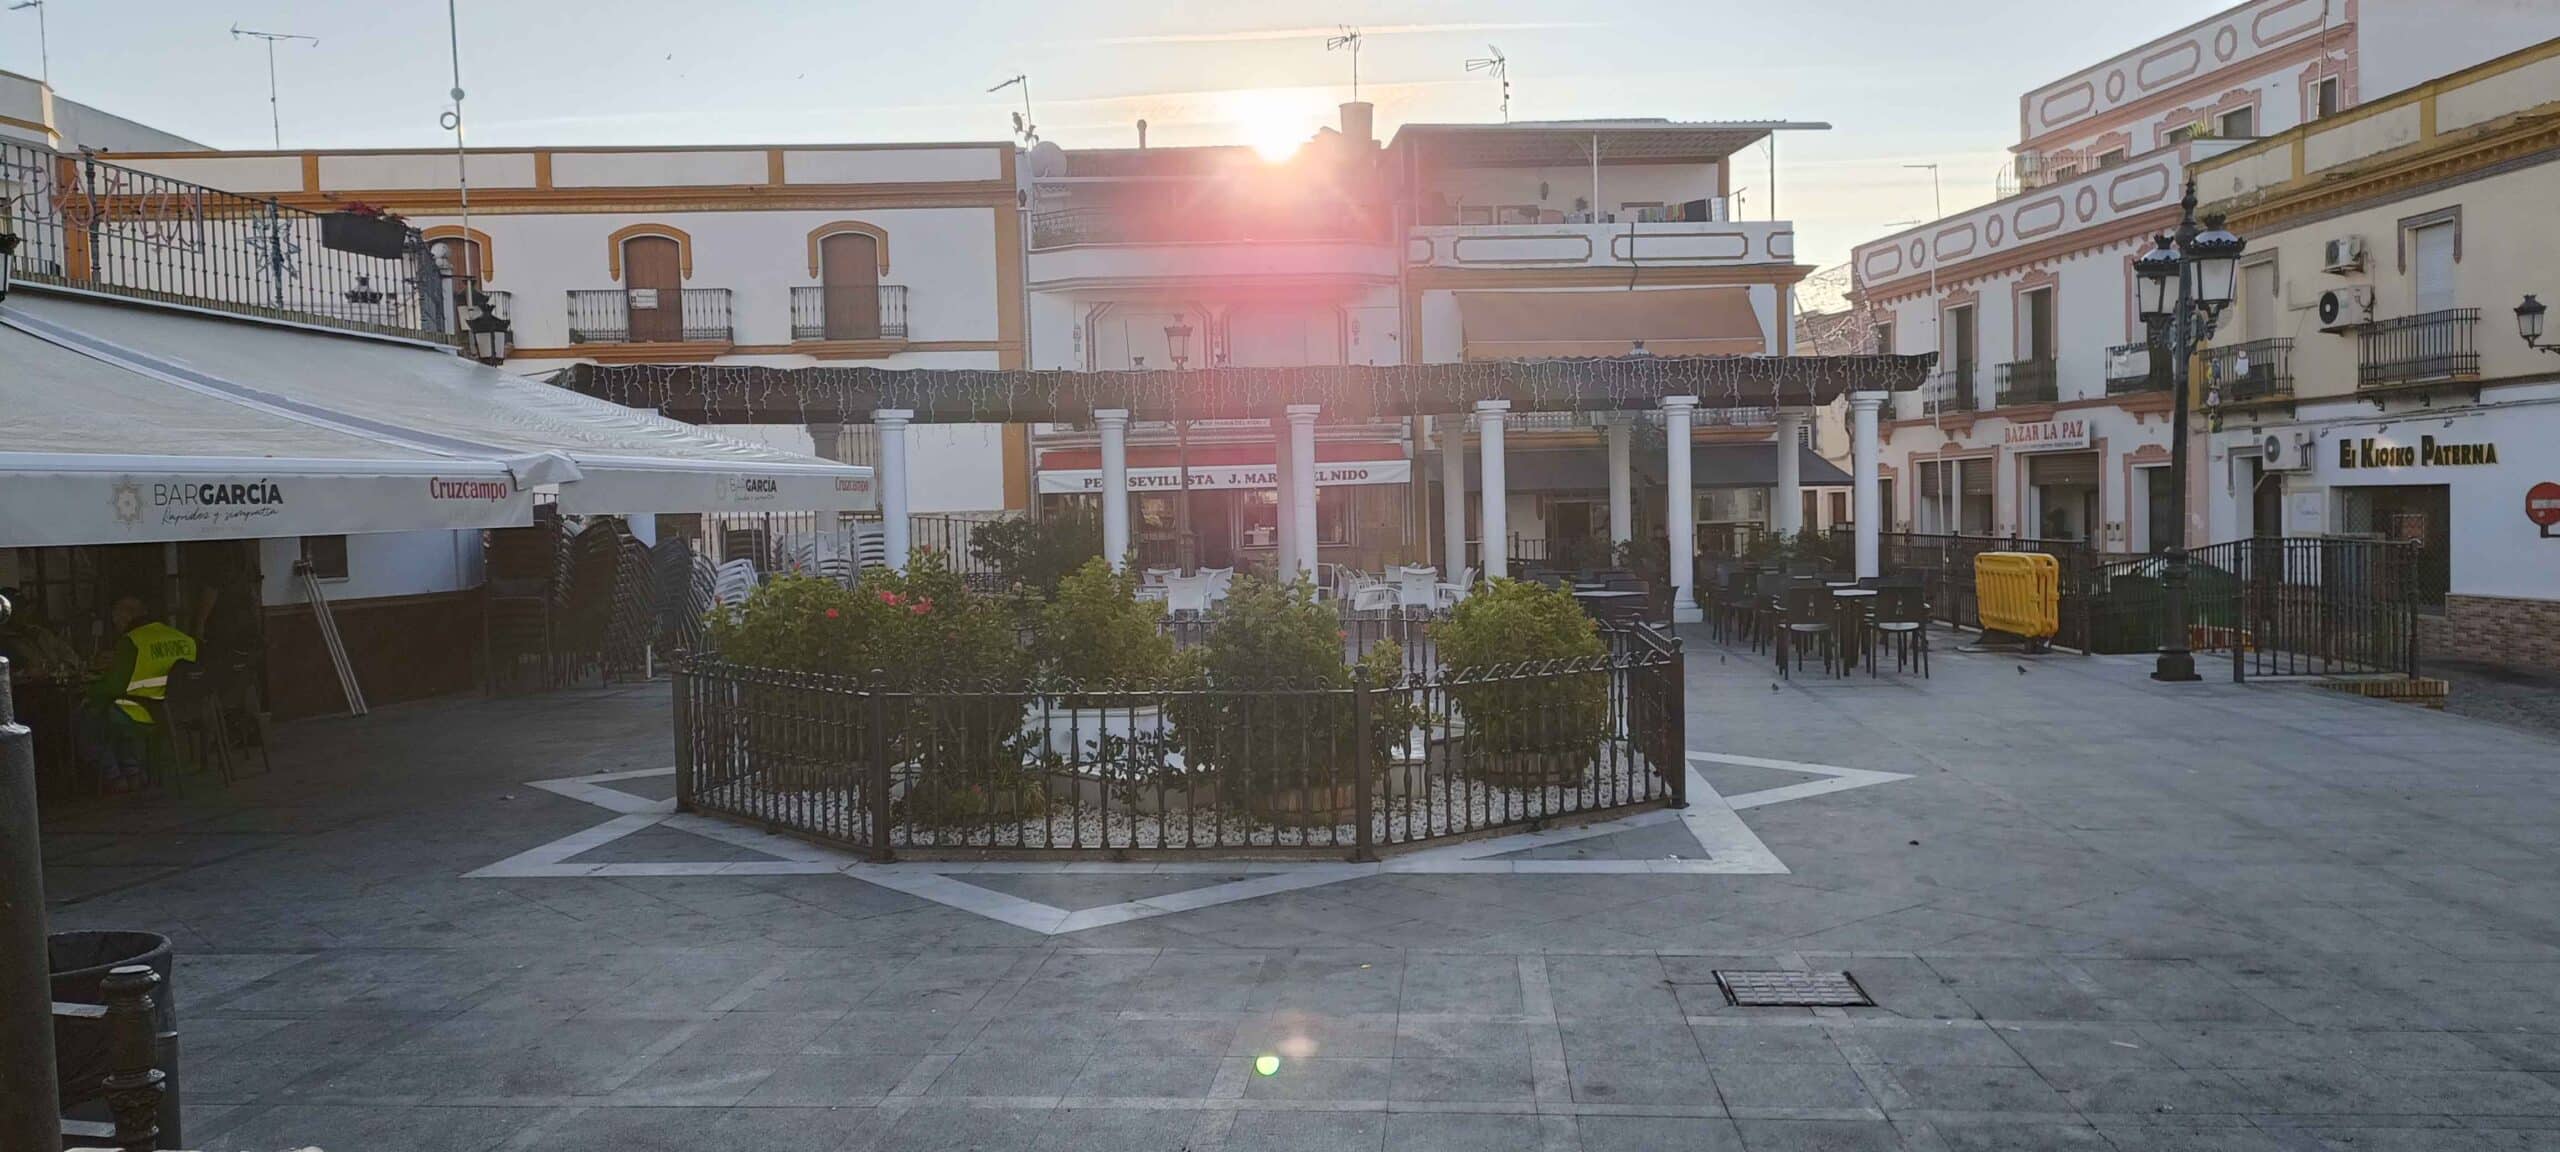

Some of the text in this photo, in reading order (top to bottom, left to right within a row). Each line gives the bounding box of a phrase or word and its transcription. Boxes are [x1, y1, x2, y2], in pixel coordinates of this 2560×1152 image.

[2005, 419, 2084, 443] BAZAR LA PAZ
[430, 476, 507, 503] Cruzcampo
[1083, 478, 1103, 488] PE
[1128, 474, 1215, 488] SEVILLSTA
[1228, 473, 1241, 485] J.
[1244, 472, 1277, 484] MAR
[1331, 469, 1369, 481] NIDO
